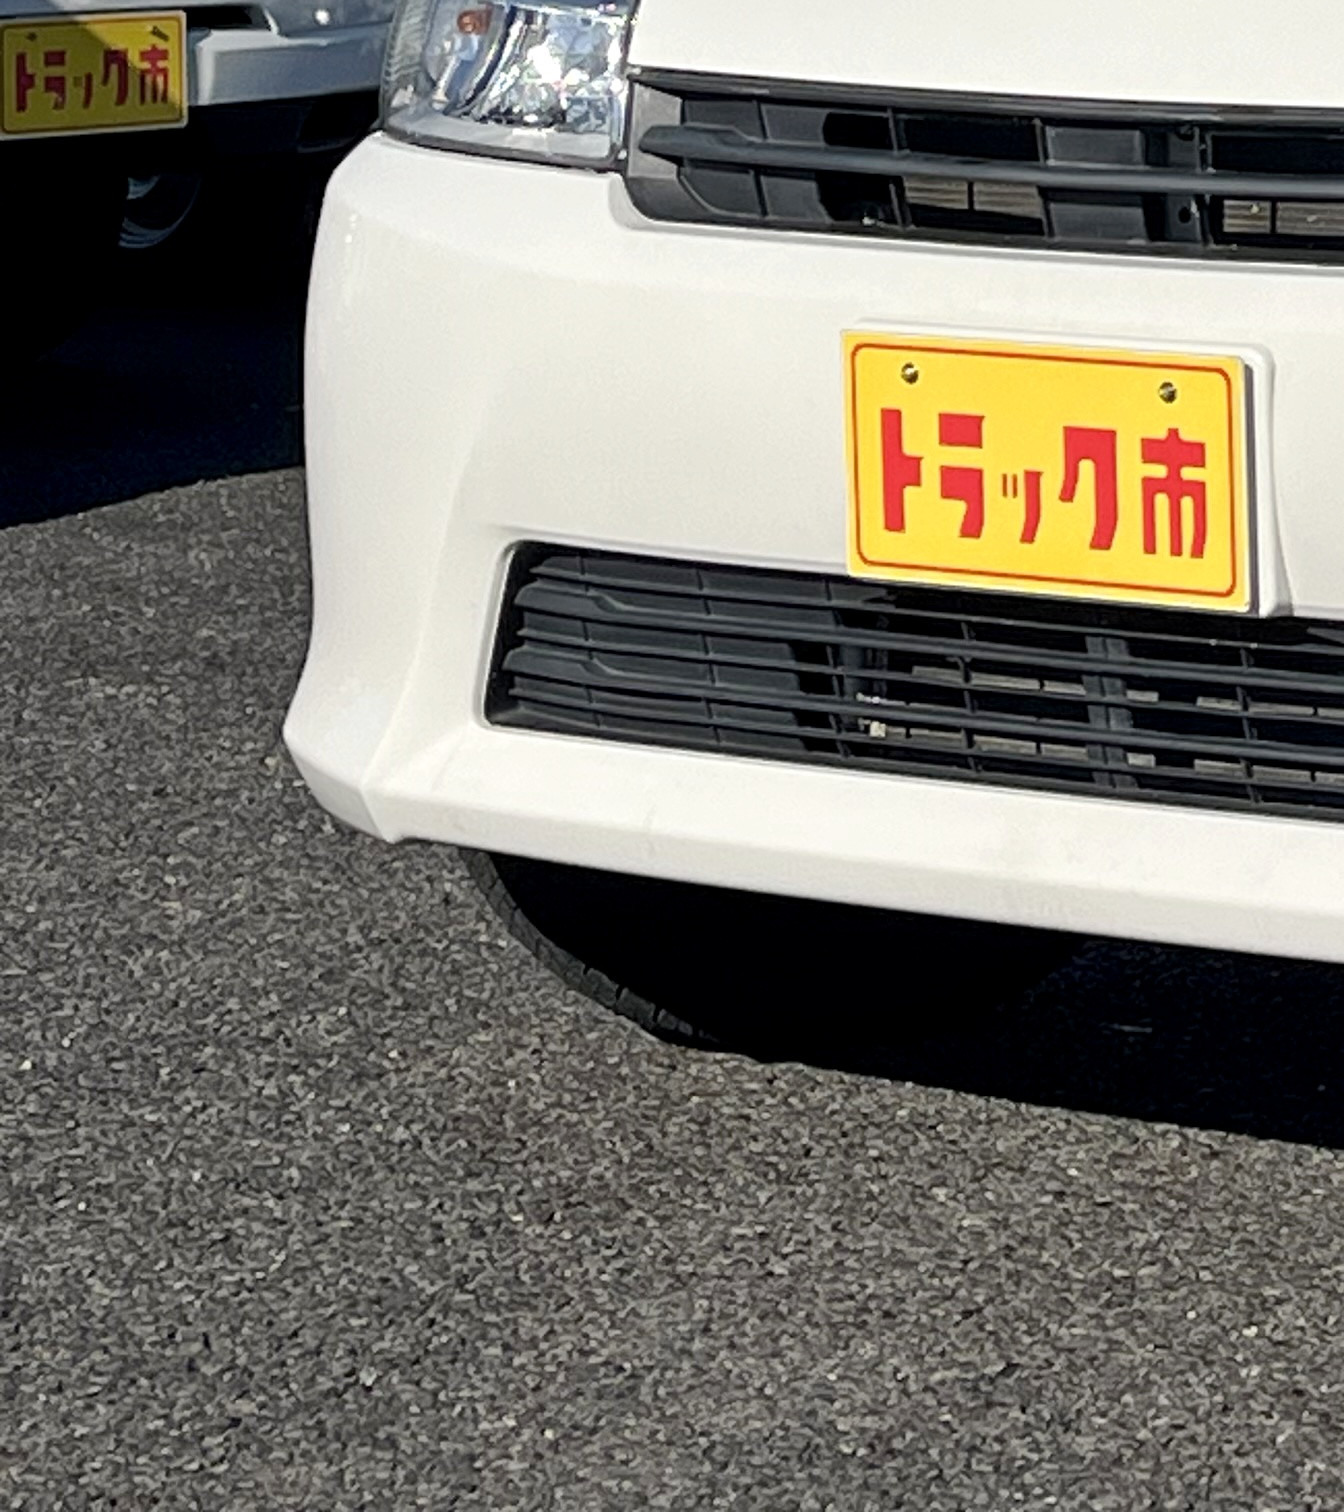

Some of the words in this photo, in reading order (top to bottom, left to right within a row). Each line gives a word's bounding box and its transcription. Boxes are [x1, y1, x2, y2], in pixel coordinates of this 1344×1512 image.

[15, 44, 169, 114] トラック市
[880, 407, 1207, 560] トラック市
